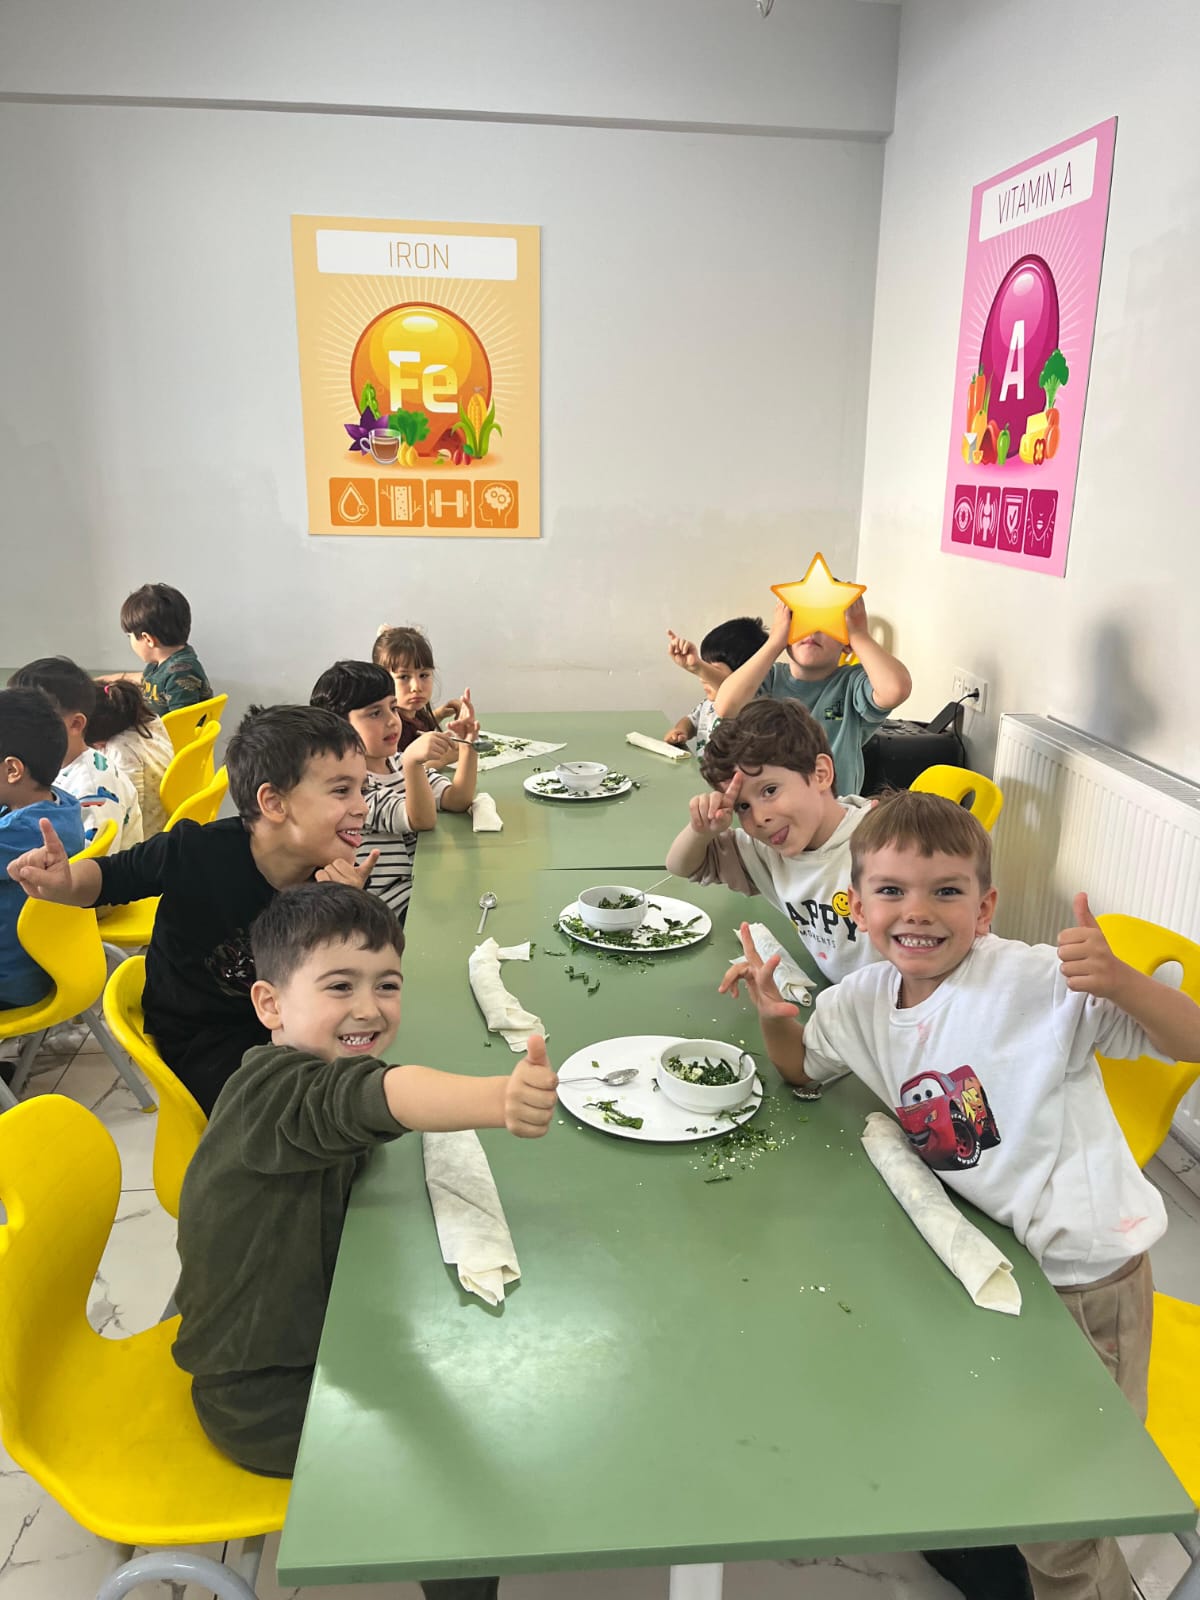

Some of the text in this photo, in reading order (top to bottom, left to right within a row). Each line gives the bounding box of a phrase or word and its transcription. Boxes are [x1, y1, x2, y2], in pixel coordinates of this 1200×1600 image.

[998, 161, 1073, 225] VITAMIN A
[389, 240, 449, 270] IRON
[388, 350, 459, 414] Fe
[999, 319, 1025, 402] A
[785, 899, 858, 942] APPY
